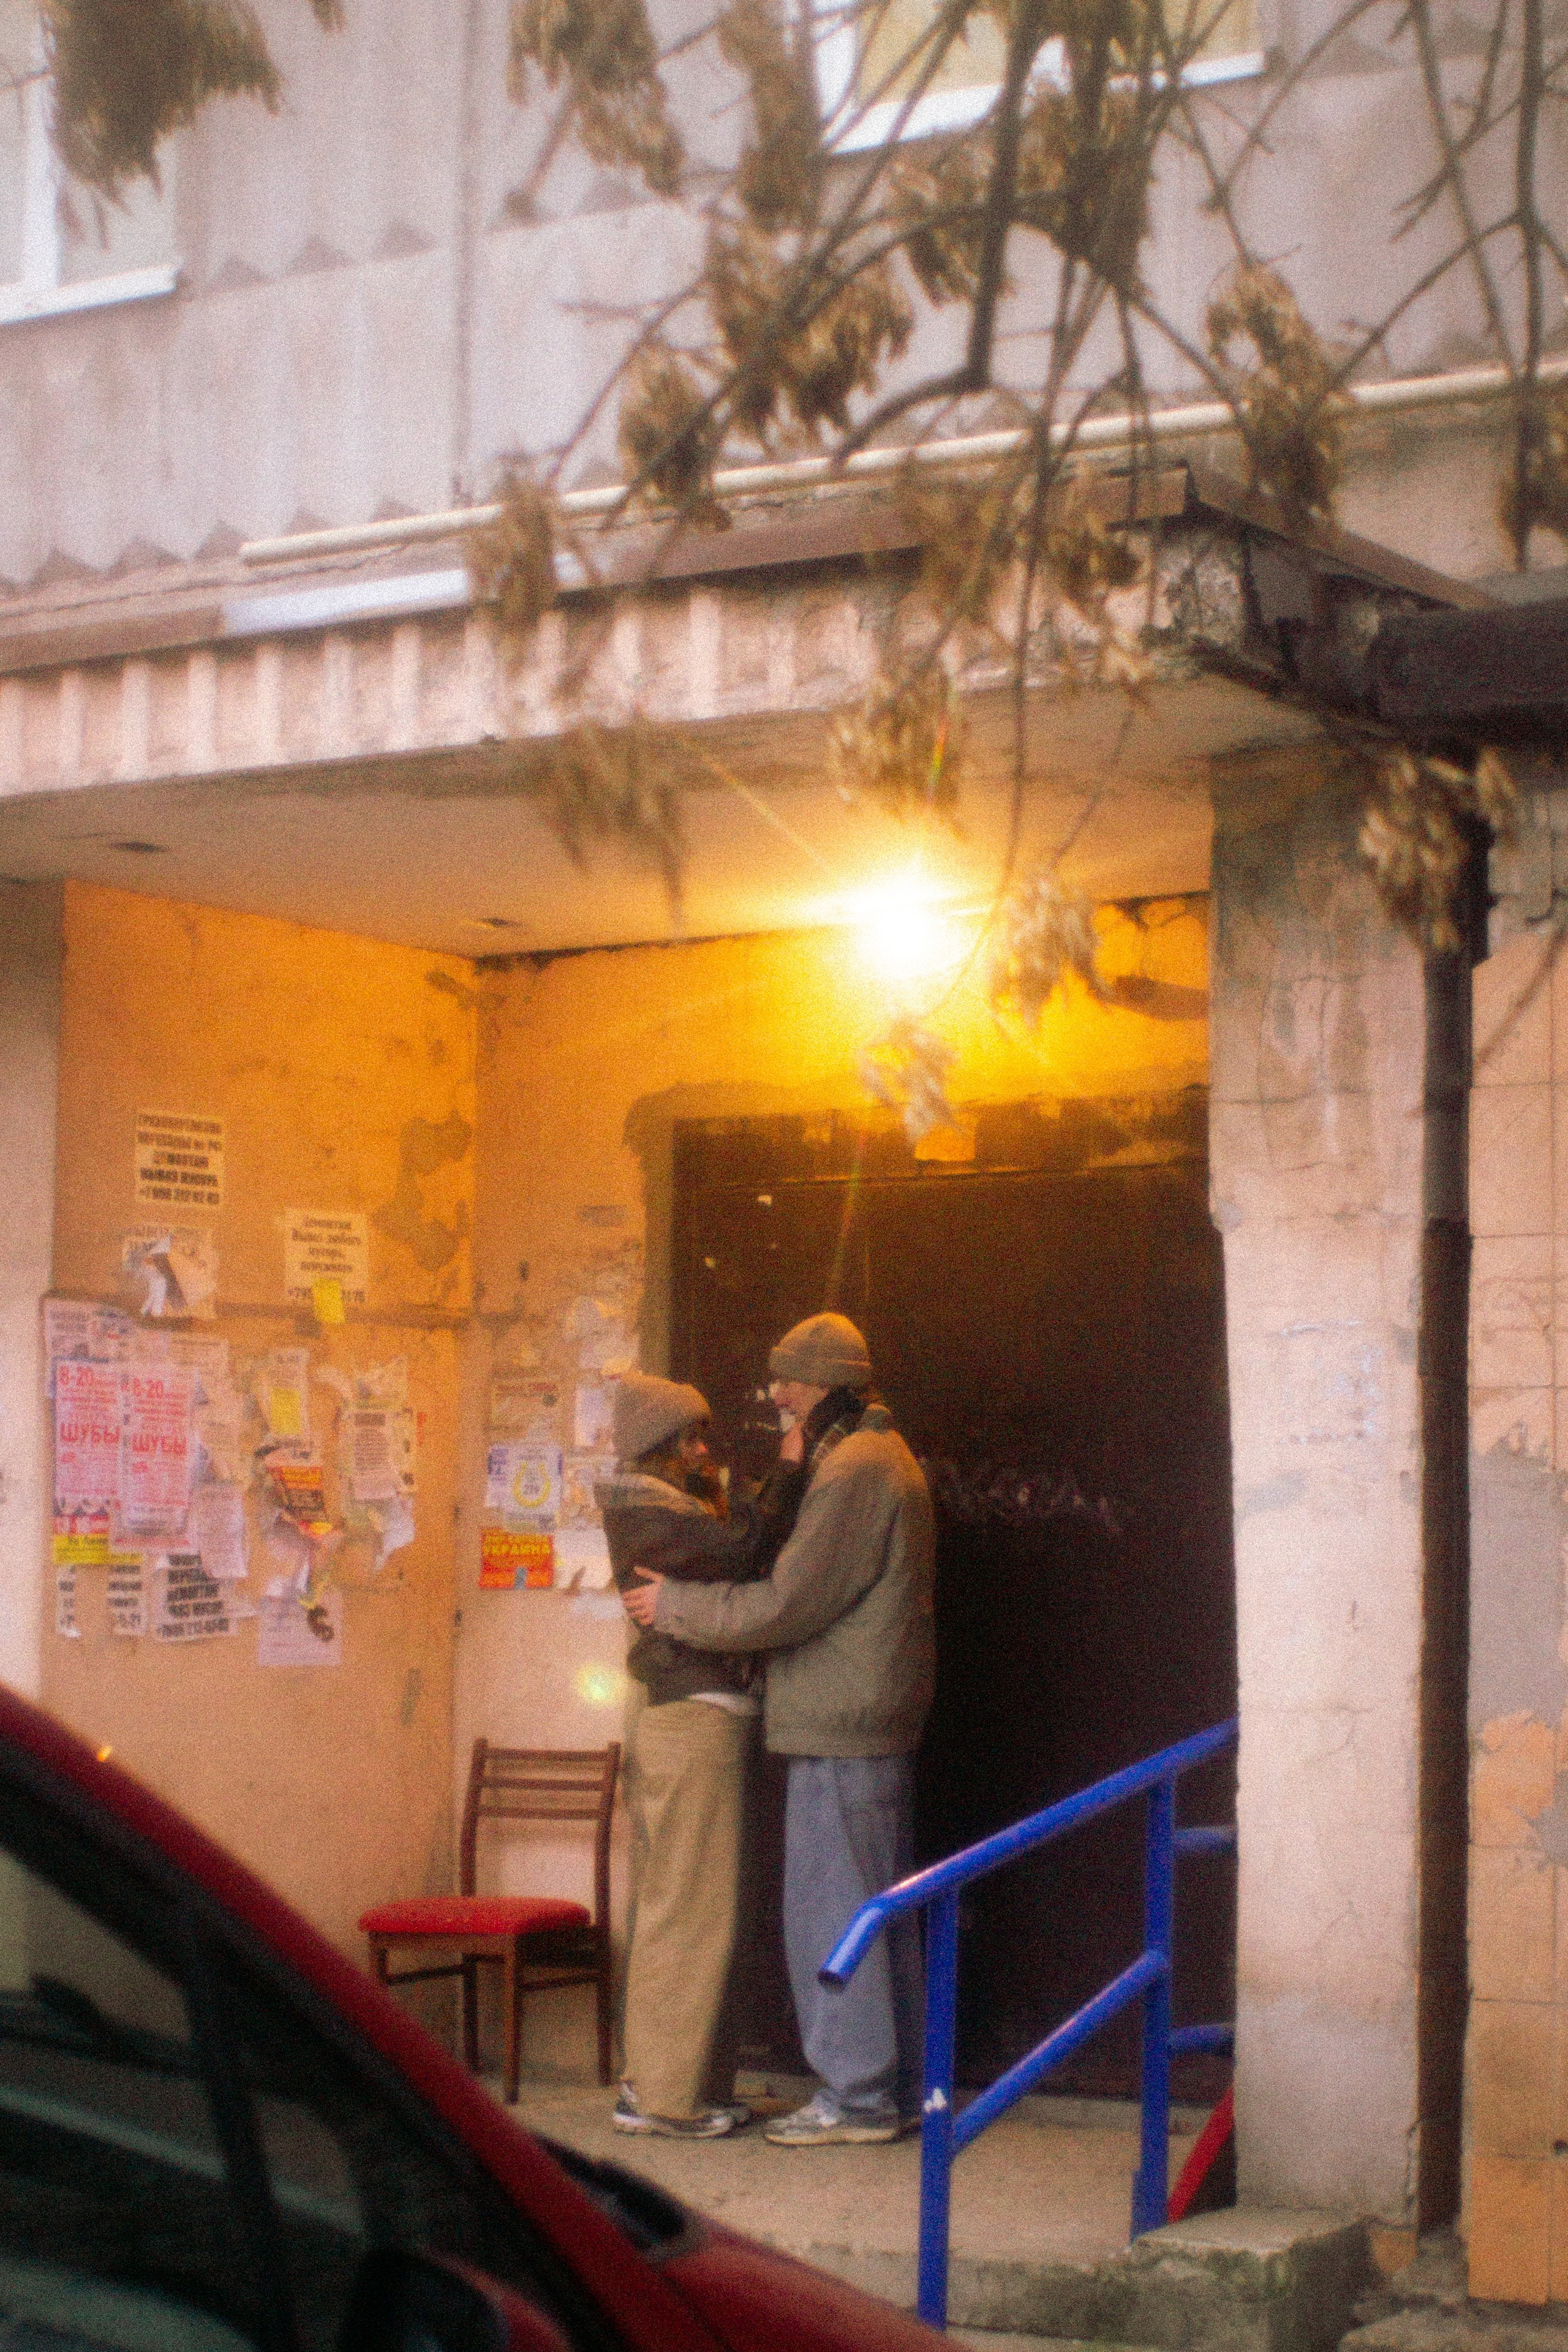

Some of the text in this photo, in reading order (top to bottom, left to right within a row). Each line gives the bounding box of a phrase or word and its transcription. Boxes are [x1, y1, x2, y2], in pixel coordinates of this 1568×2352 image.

[59, 1366, 94, 1387] 8-20
[60, 1421, 121, 1444] ШУБЫ
[132, 1433, 187, 1455] ШУБЫ
